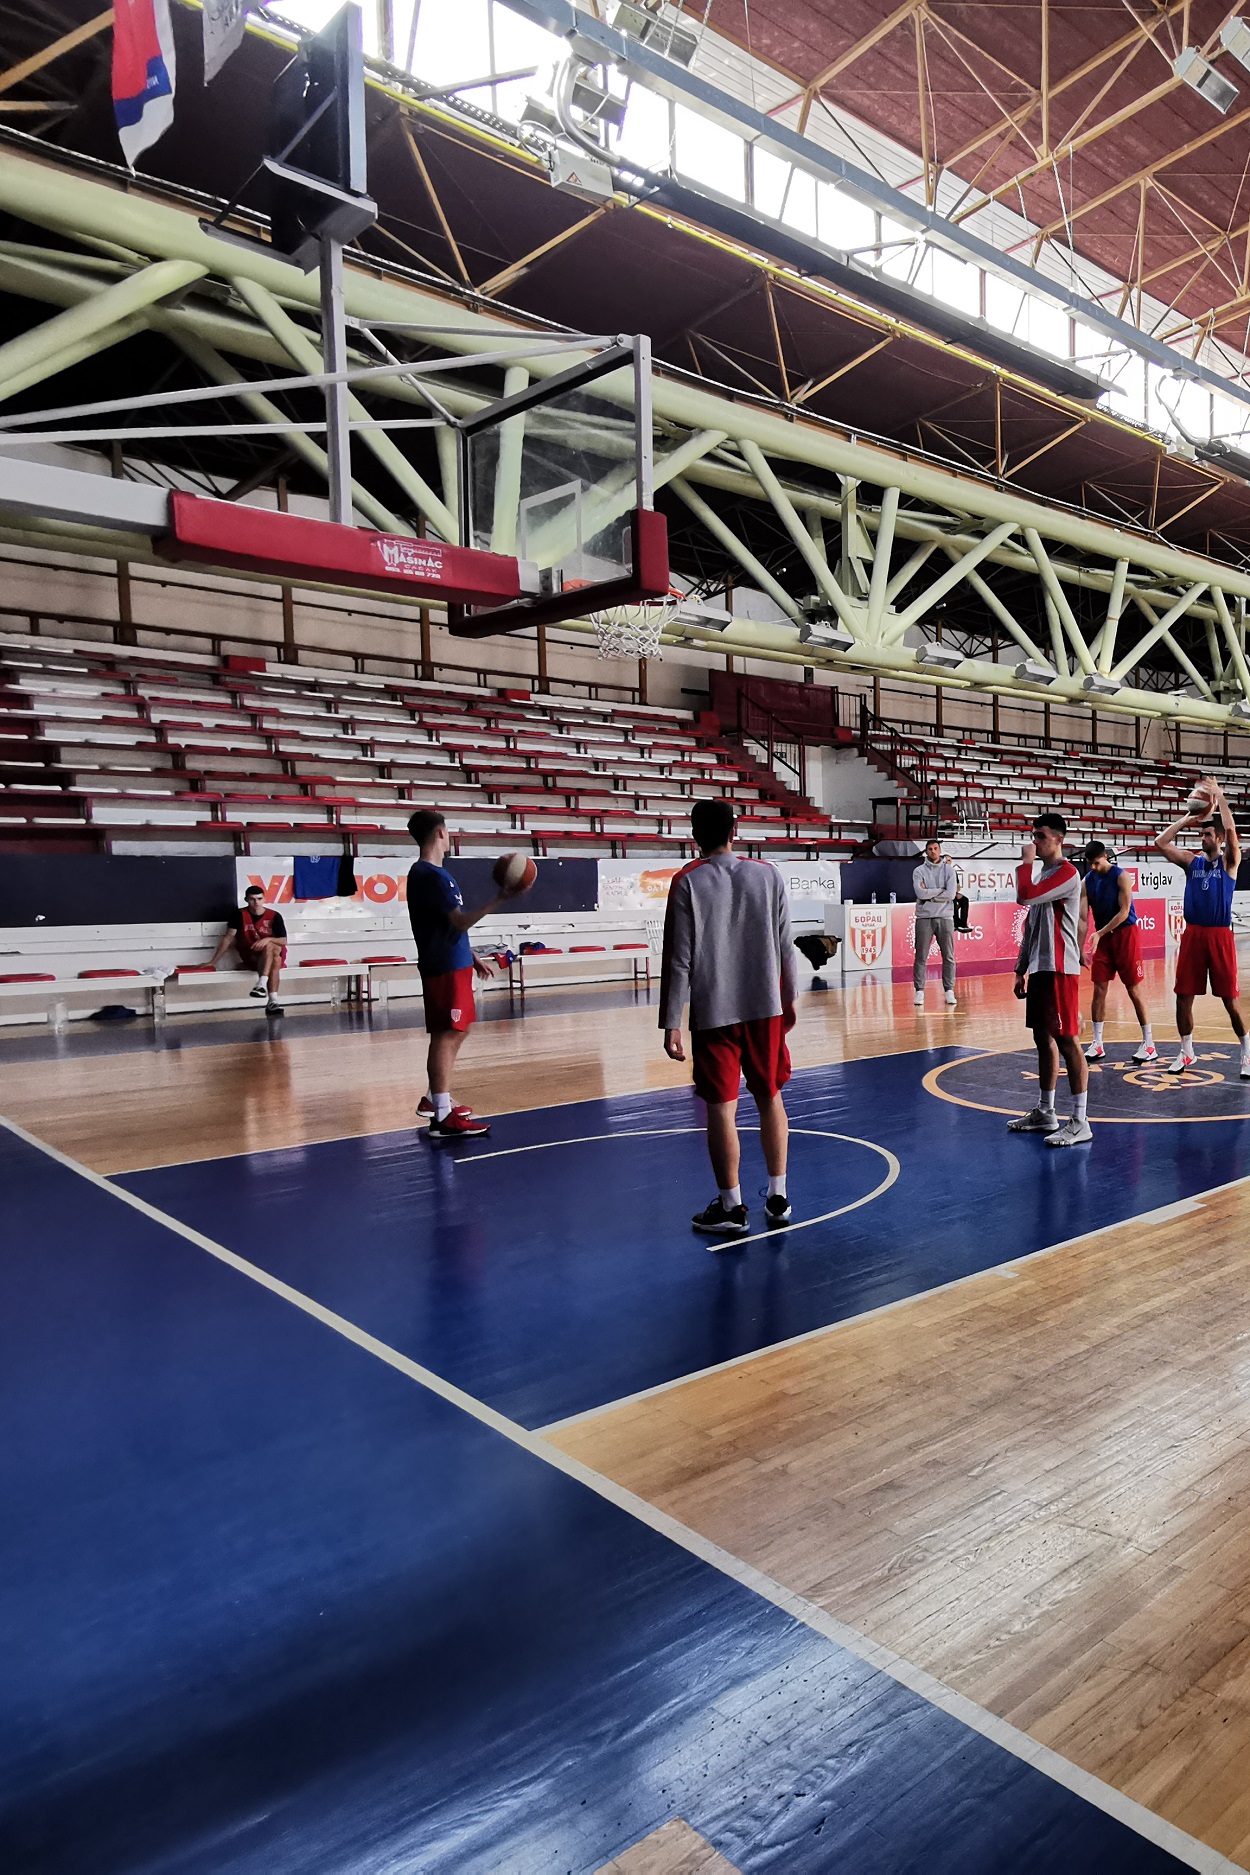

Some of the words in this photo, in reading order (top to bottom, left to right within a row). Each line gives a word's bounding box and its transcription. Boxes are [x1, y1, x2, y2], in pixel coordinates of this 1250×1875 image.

[790, 877, 835, 890] Banka
[1141, 872, 1173, 890] triglav
[862, 947, 877, 955] 1945
